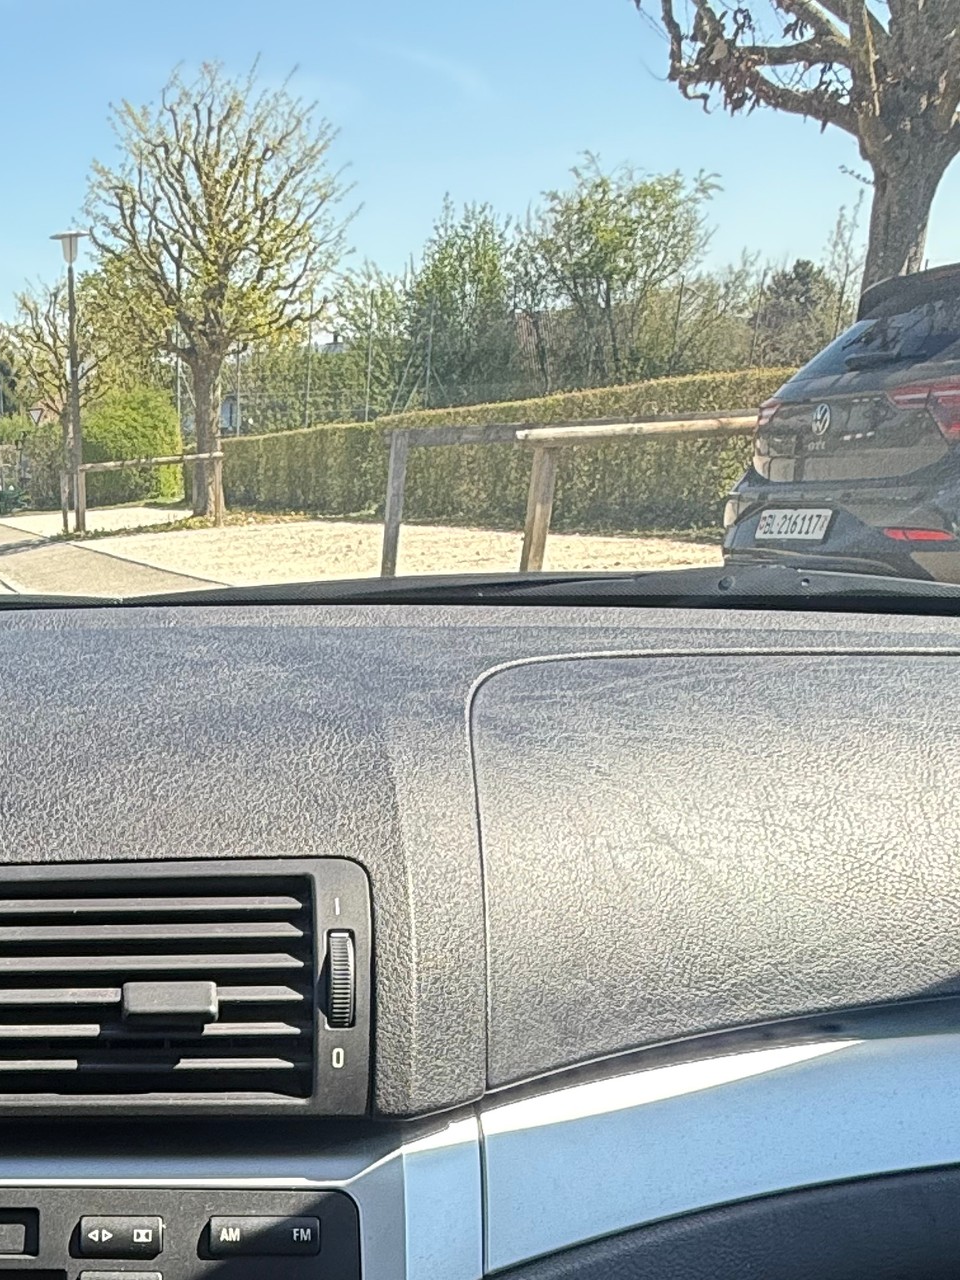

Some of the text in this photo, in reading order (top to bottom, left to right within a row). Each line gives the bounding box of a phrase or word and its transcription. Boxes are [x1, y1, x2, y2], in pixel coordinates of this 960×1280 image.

[777, 514, 822, 535] 216117
[219, 1227, 312, 1243] AM FM
